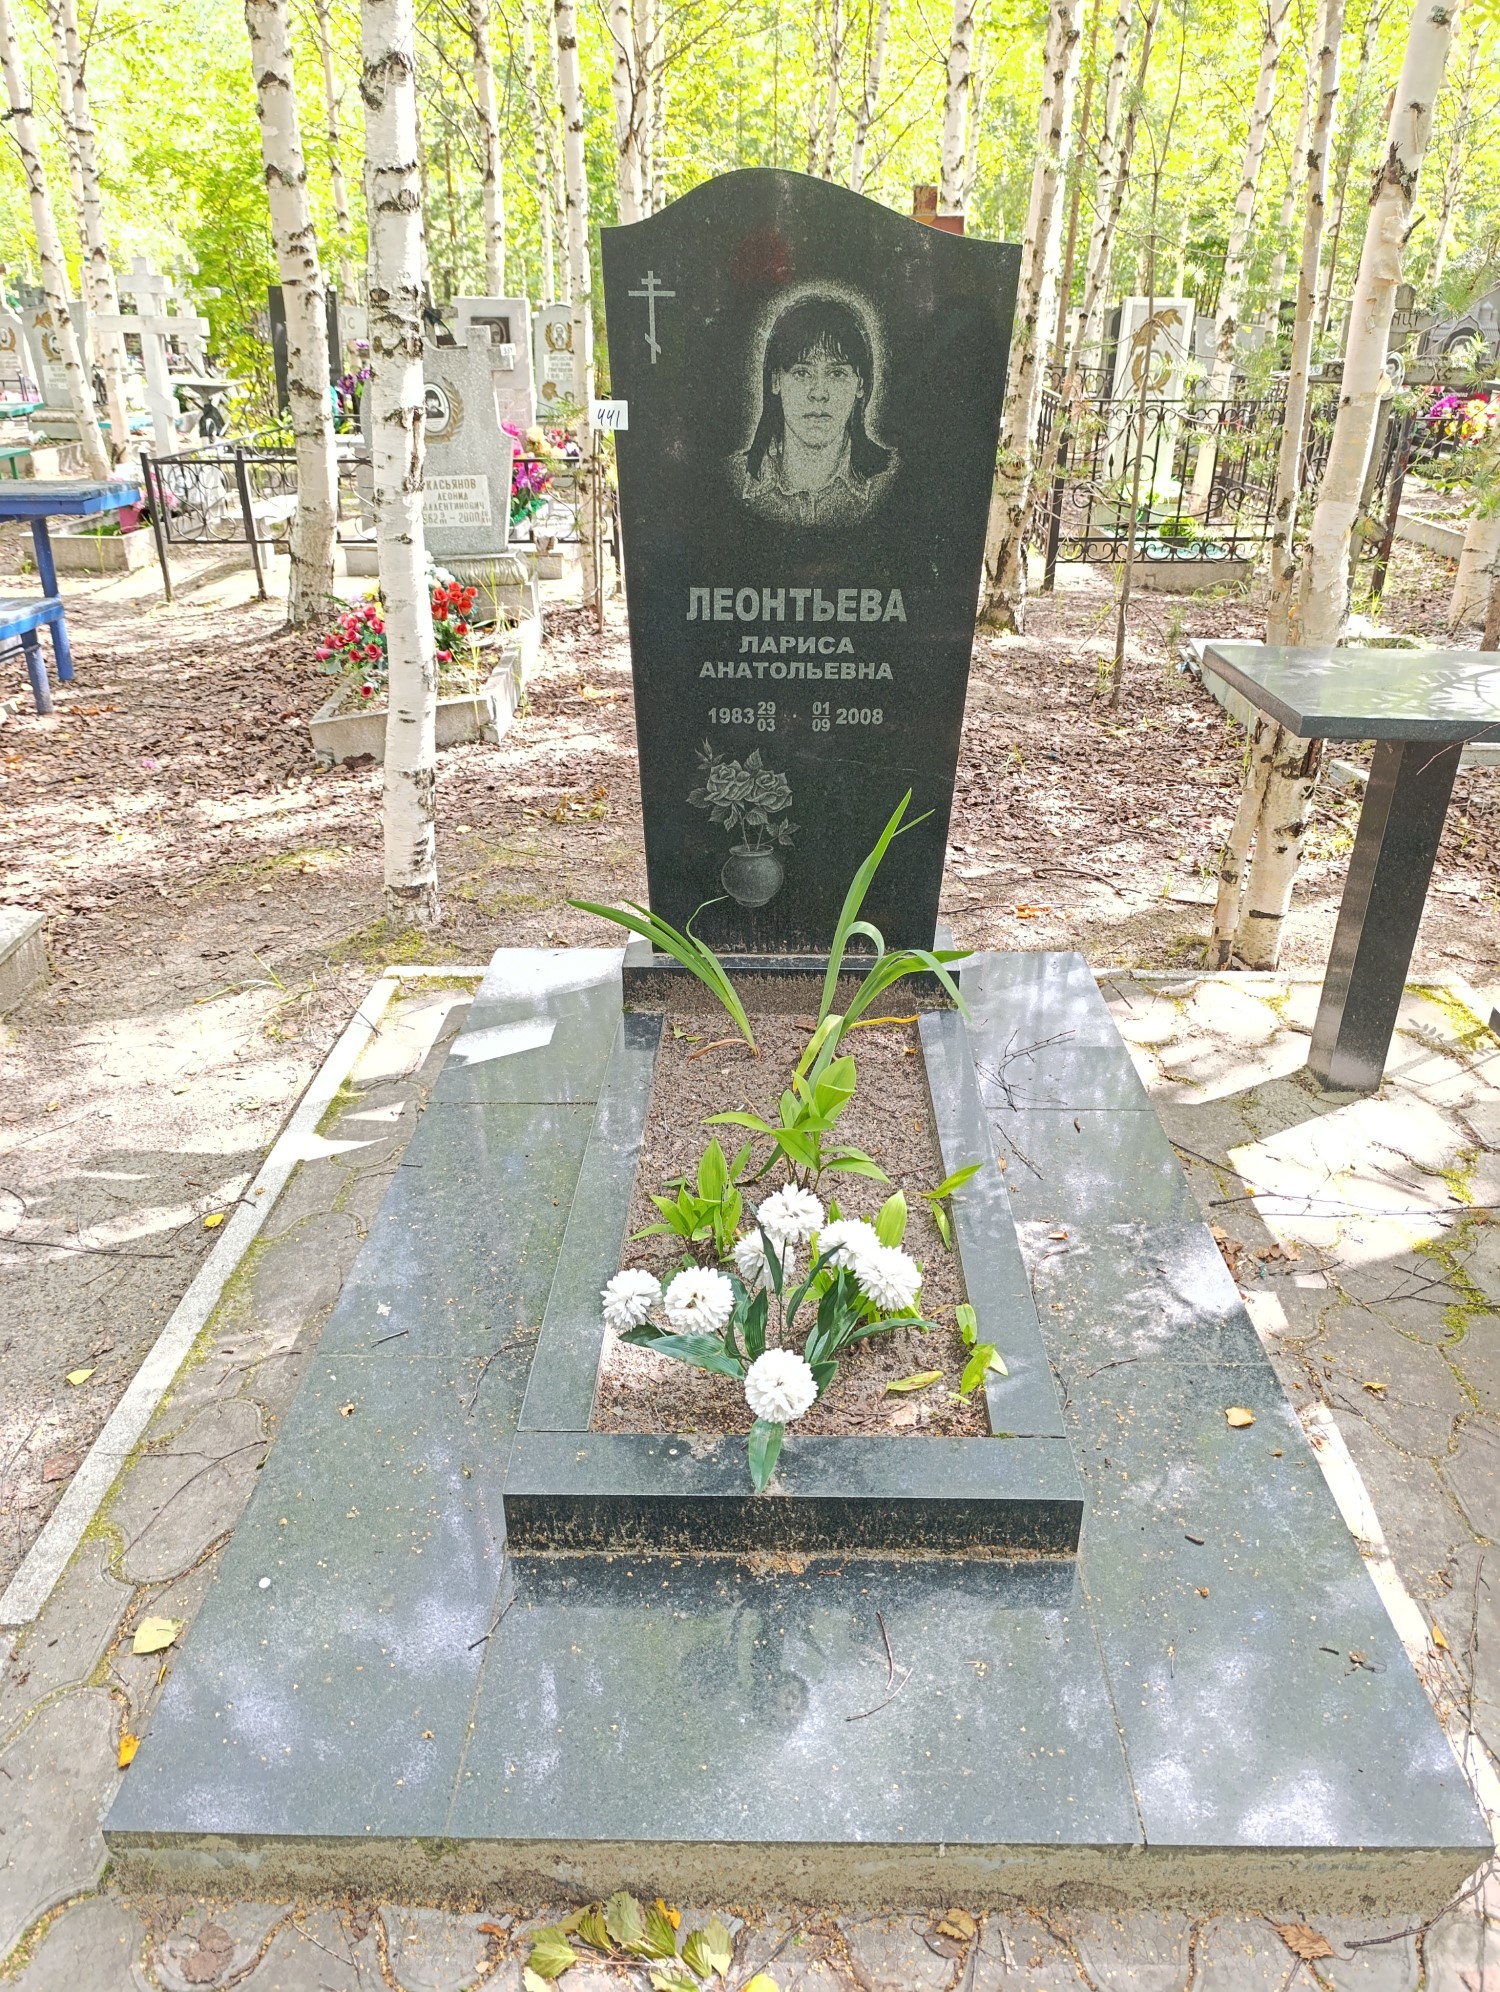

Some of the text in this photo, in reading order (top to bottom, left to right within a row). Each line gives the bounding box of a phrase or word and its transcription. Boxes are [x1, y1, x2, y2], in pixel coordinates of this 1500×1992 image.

[597, 408, 621, 428] 441
[426, 478, 477, 491] КАСЬЯНОВ
[437, 492, 469, 501] ЛЕОНИД
[422, 511, 439, 525] 962
[686, 587, 907, 622] ЛЕОНТЬЕВА
[739, 635, 855, 654] ЛАРИСА
[699, 661, 894, 680] АНАТОЛЬЕВНА
[708, 701, 884, 732] 1983 29 03 01 09 2008
